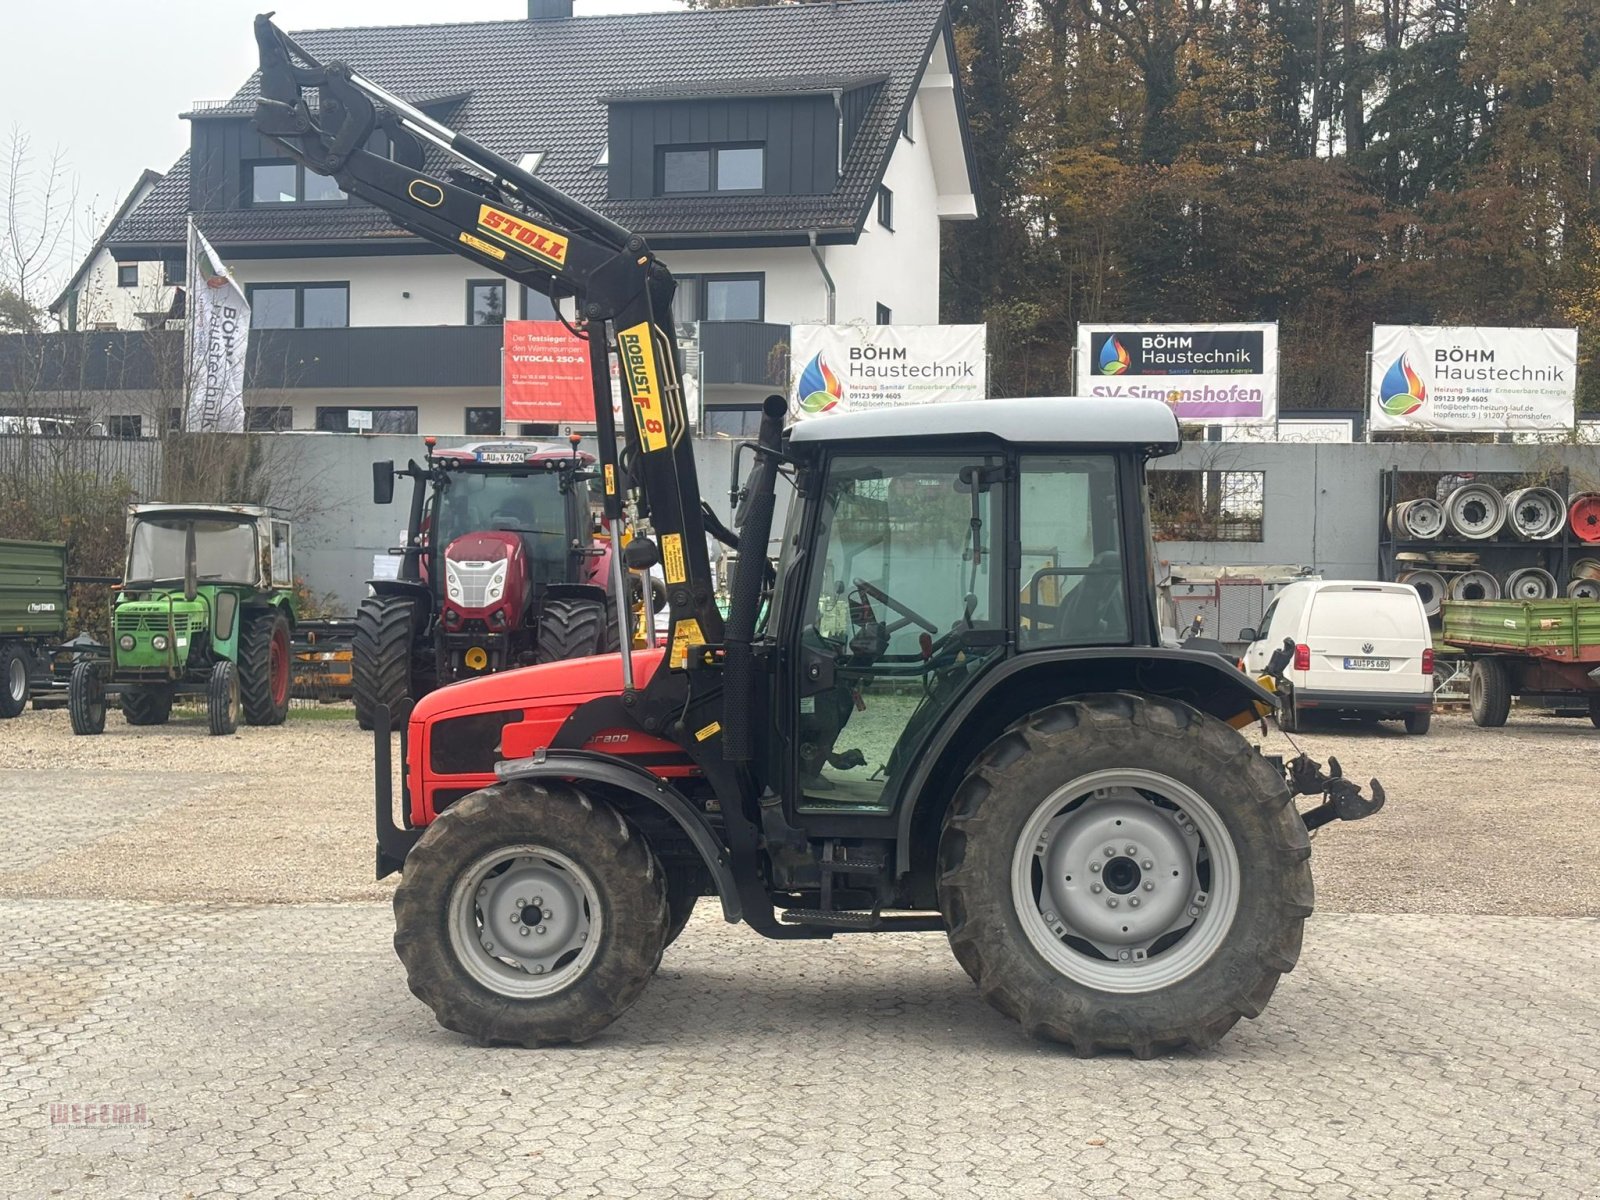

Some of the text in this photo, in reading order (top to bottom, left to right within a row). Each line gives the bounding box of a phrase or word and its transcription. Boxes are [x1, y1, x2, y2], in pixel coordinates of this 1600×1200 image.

[483, 210, 564, 260] STOLL
[527, 334, 566, 344] Testsieger
[1142, 334, 1192, 349] BÖHM
[850, 343, 907, 360] BÖHM
[1142, 349, 1250, 364] Haustechnik
[1435, 345, 1495, 362] BÖHM
[626, 334, 651, 394] ROBUST
[850, 361, 974, 378] Haustechnik
[1435, 365, 1564, 382] Haustechnik
[633, 396, 651, 410] F
[1434, 411, 1470, 420] Hopfenstr.
[1506, 412, 1551, 420] Simonshofen
[645, 419, 662, 434] 8
[506, 453, 523, 461] 7624
[1348, 659, 1362, 667] LAU
